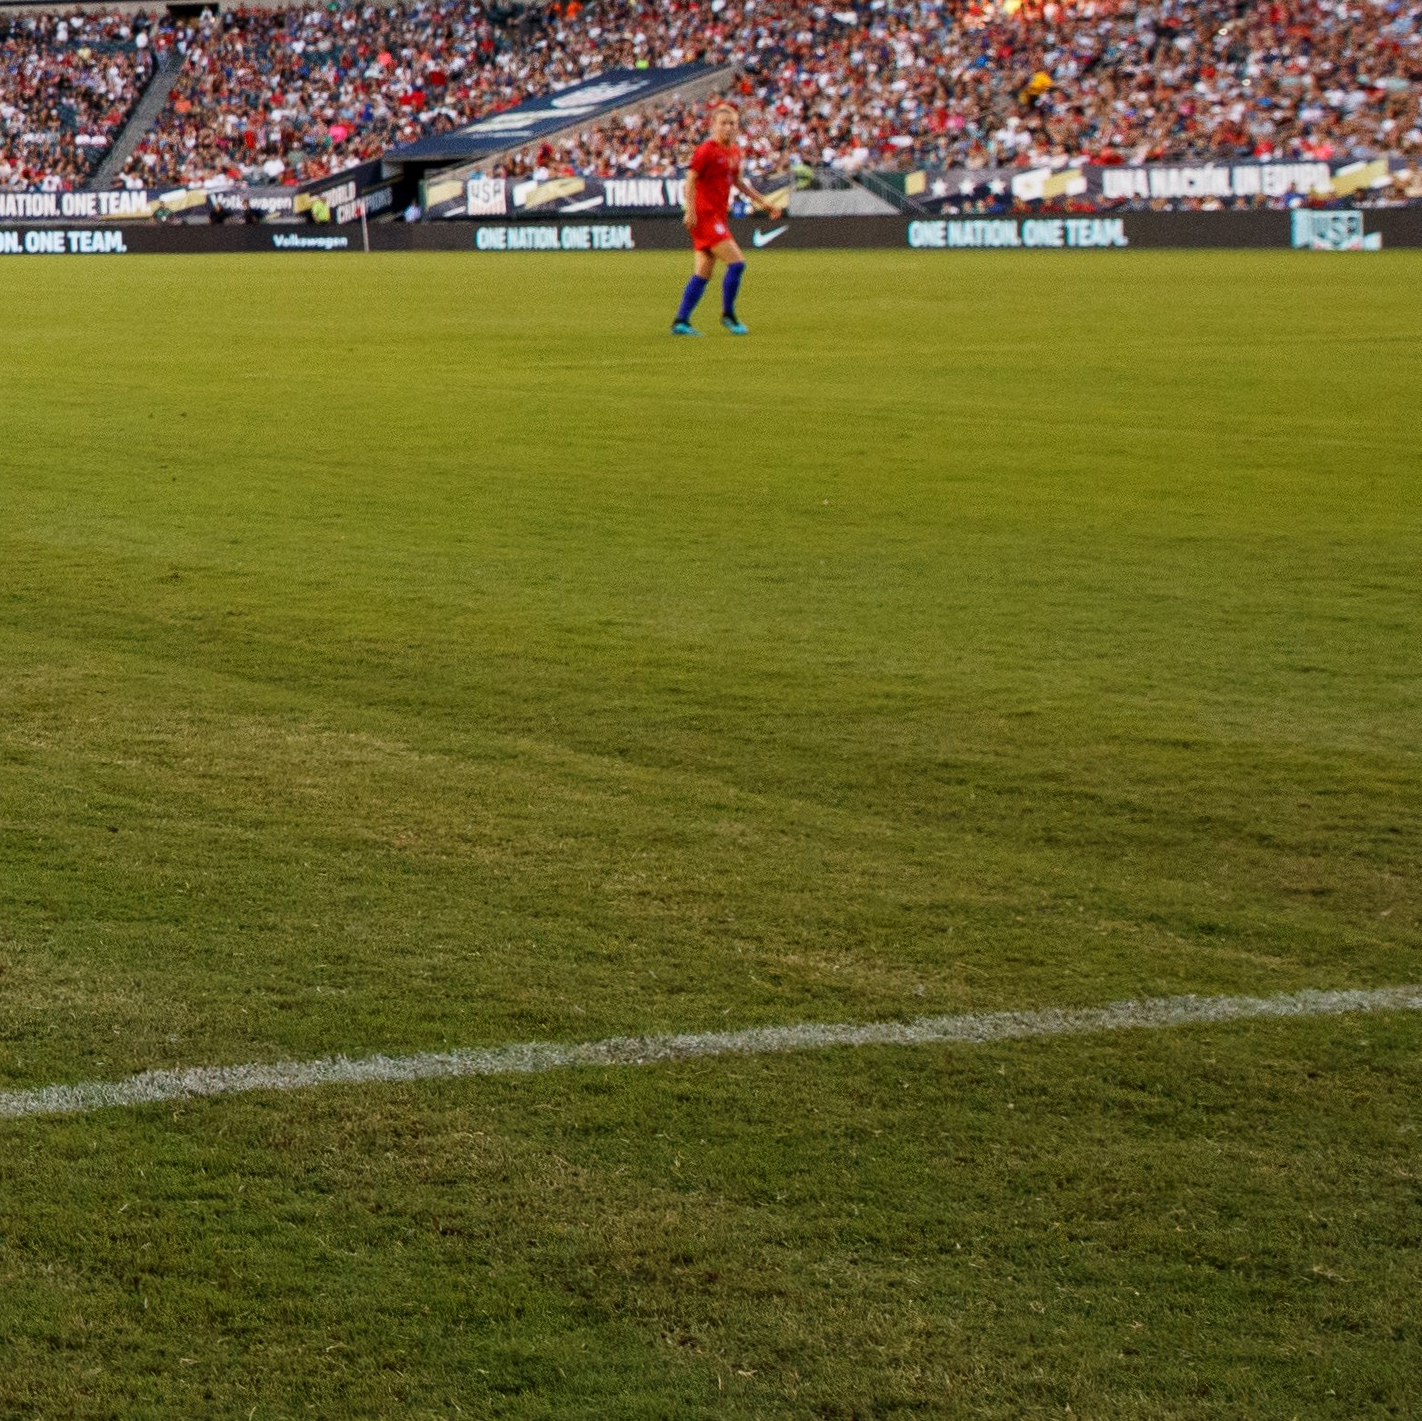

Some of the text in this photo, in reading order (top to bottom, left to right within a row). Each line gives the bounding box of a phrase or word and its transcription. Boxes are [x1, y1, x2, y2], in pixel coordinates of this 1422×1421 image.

[62, 192, 98, 216] ONE
[98, 190, 152, 214] TEAM.
[605, 179, 665, 206] THANK
[24, 230, 67, 253] ONE
[67, 230, 128, 253] TEAM.
[272, 233, 348, 249] Volkswagen
[476, 226, 635, 249] ONE NATION. ONE TEAM.
[908, 218, 1128, 247] ONE NATION. ONE TEAM.
